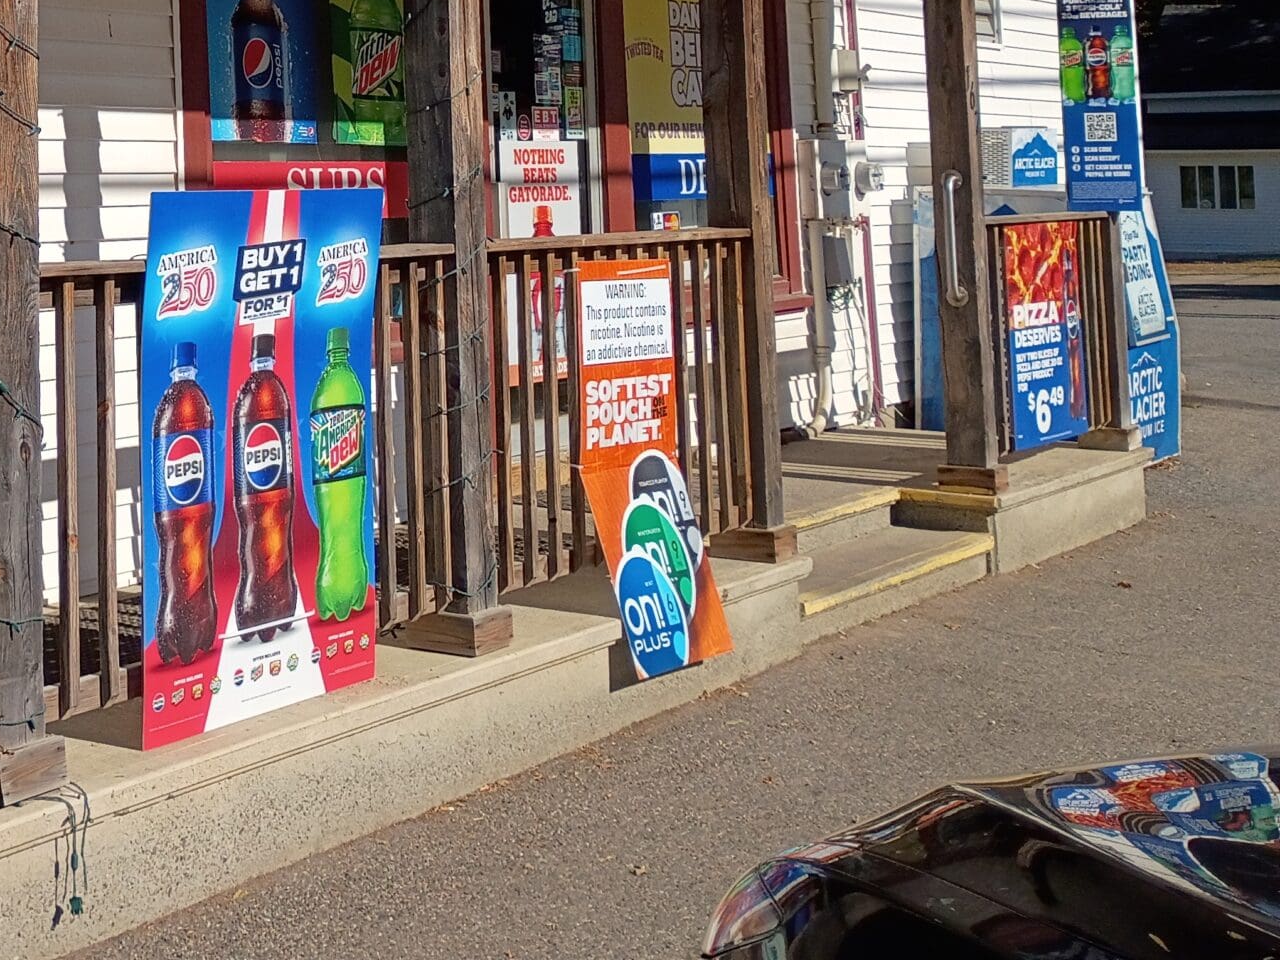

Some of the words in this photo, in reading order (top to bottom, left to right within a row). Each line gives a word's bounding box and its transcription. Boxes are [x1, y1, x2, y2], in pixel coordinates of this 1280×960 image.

[625, 41, 651, 61] TWISTED
[652, 43, 664, 63] TEA
[273, 44, 283, 88] pepsi
[534, 110, 558, 123] EBT
[635, 122, 656, 138] FOR
[658, 122, 681, 138] OUR
[513, 149, 565, 165] NOTHING
[523, 168, 557, 183] BEATS
[509, 185, 571, 203] GATORADE.
[159, 248, 216, 273] AMERICA
[242, 244, 291, 270] BUY
[293, 242, 302, 262] 1
[319, 241, 366, 263] AMERICA
[1122, 245, 1147, 262] PARTY
[240, 267, 287, 293] GET
[290, 265, 299, 285] 1
[318, 258, 366, 302] 250
[159, 267, 215, 316] 250
[605, 283, 647, 299] WARNING:
[244, 298, 274, 314] FOR
[586, 305, 602, 320] This
[604, 304, 633, 322] product
[635, 302, 666, 317] contains
[1013, 301, 1059, 329] PIZZA
[591, 324, 622, 340] nicotine.
[624, 321, 655, 337] Nicotine
[657, 323, 664, 336] is
[1014, 325, 1061, 348] DESERVES
[587, 348, 596, 360] an
[598, 342, 631, 359] addictive
[586, 373, 672, 404] SOFTEST
[653, 396, 664, 407] ON
[1131, 392, 1166, 424] LACIER
[587, 398, 652, 427] POUCH
[652, 406, 667, 419] THE
[586, 419, 662, 450] PLANET.
[1154, 420, 1165, 434] ICE
[246, 447, 281, 465] PEPSI
[167, 460, 202, 479] PEPSI
[624, 592, 666, 636] on!
[667, 593, 674, 612] 6
[634, 632, 671, 655] PLUS
